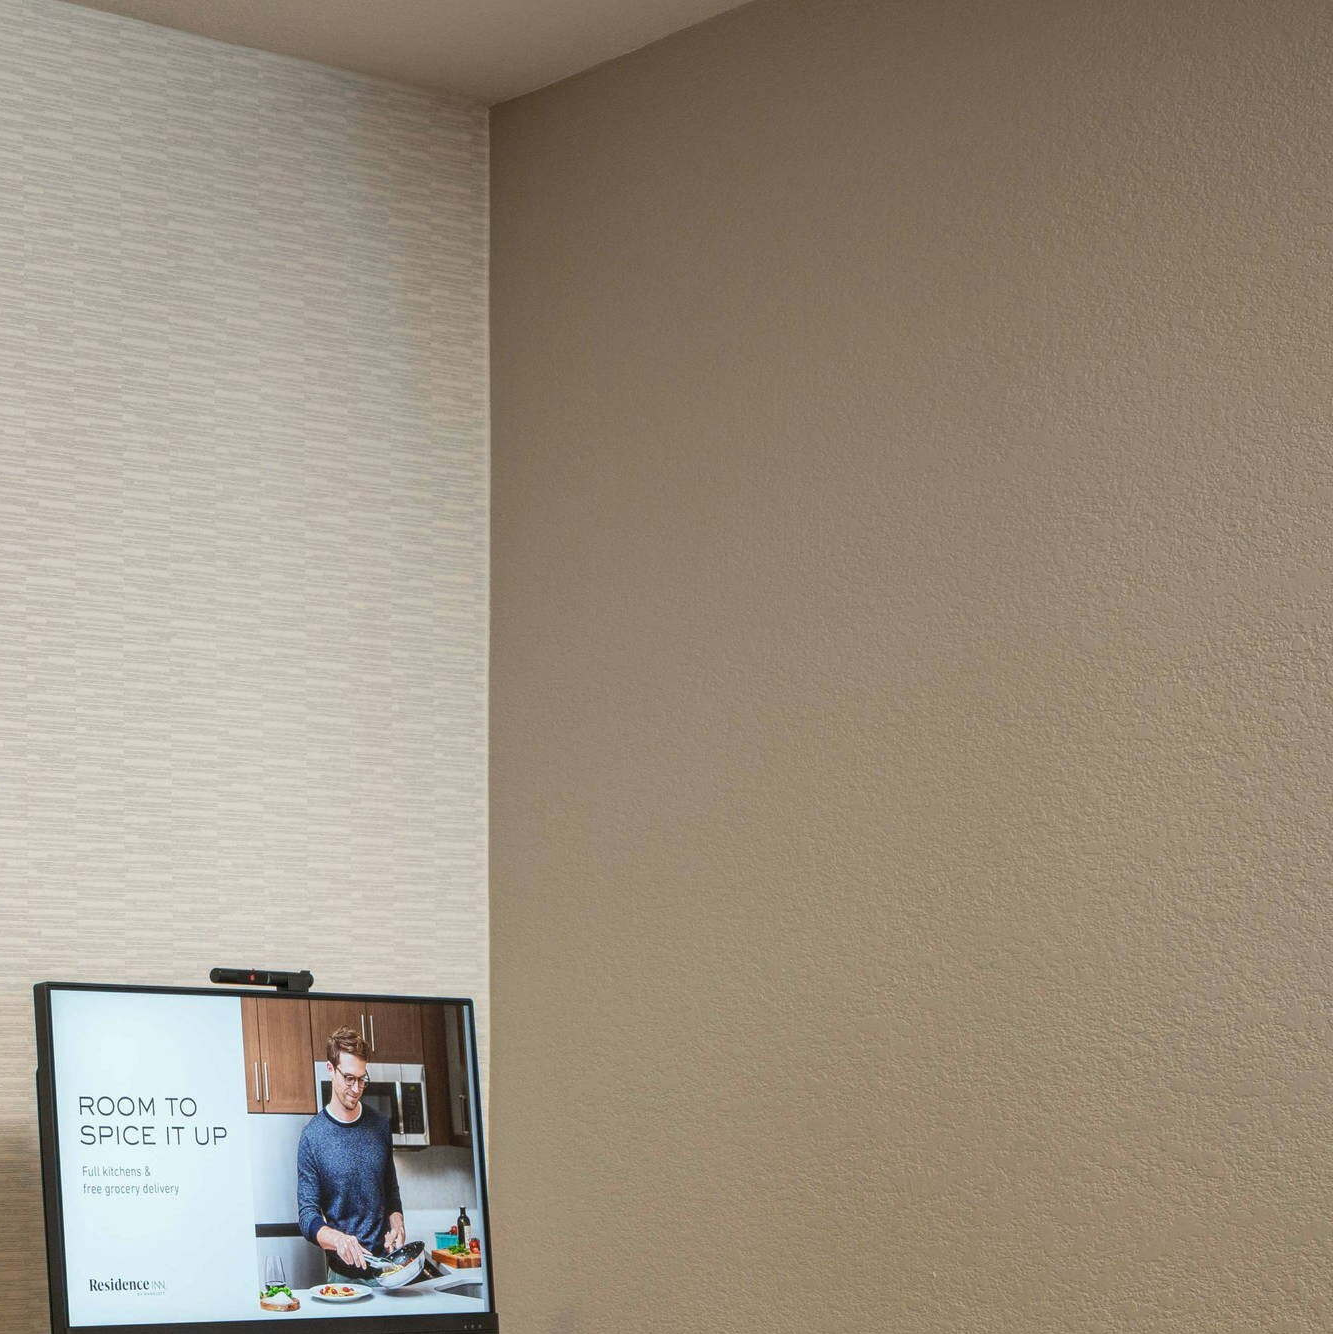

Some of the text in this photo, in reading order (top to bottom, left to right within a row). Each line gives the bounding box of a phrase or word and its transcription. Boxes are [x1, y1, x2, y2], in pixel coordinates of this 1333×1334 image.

[79, 1096, 197, 1117] ROOM TO
[80, 1125, 227, 1145] SPICE IT UP
[83, 1166, 151, 1177] Full kitchens &
[83, 1184, 179, 1196] free grocery delivery
[89, 1278, 149, 1291] Residence
